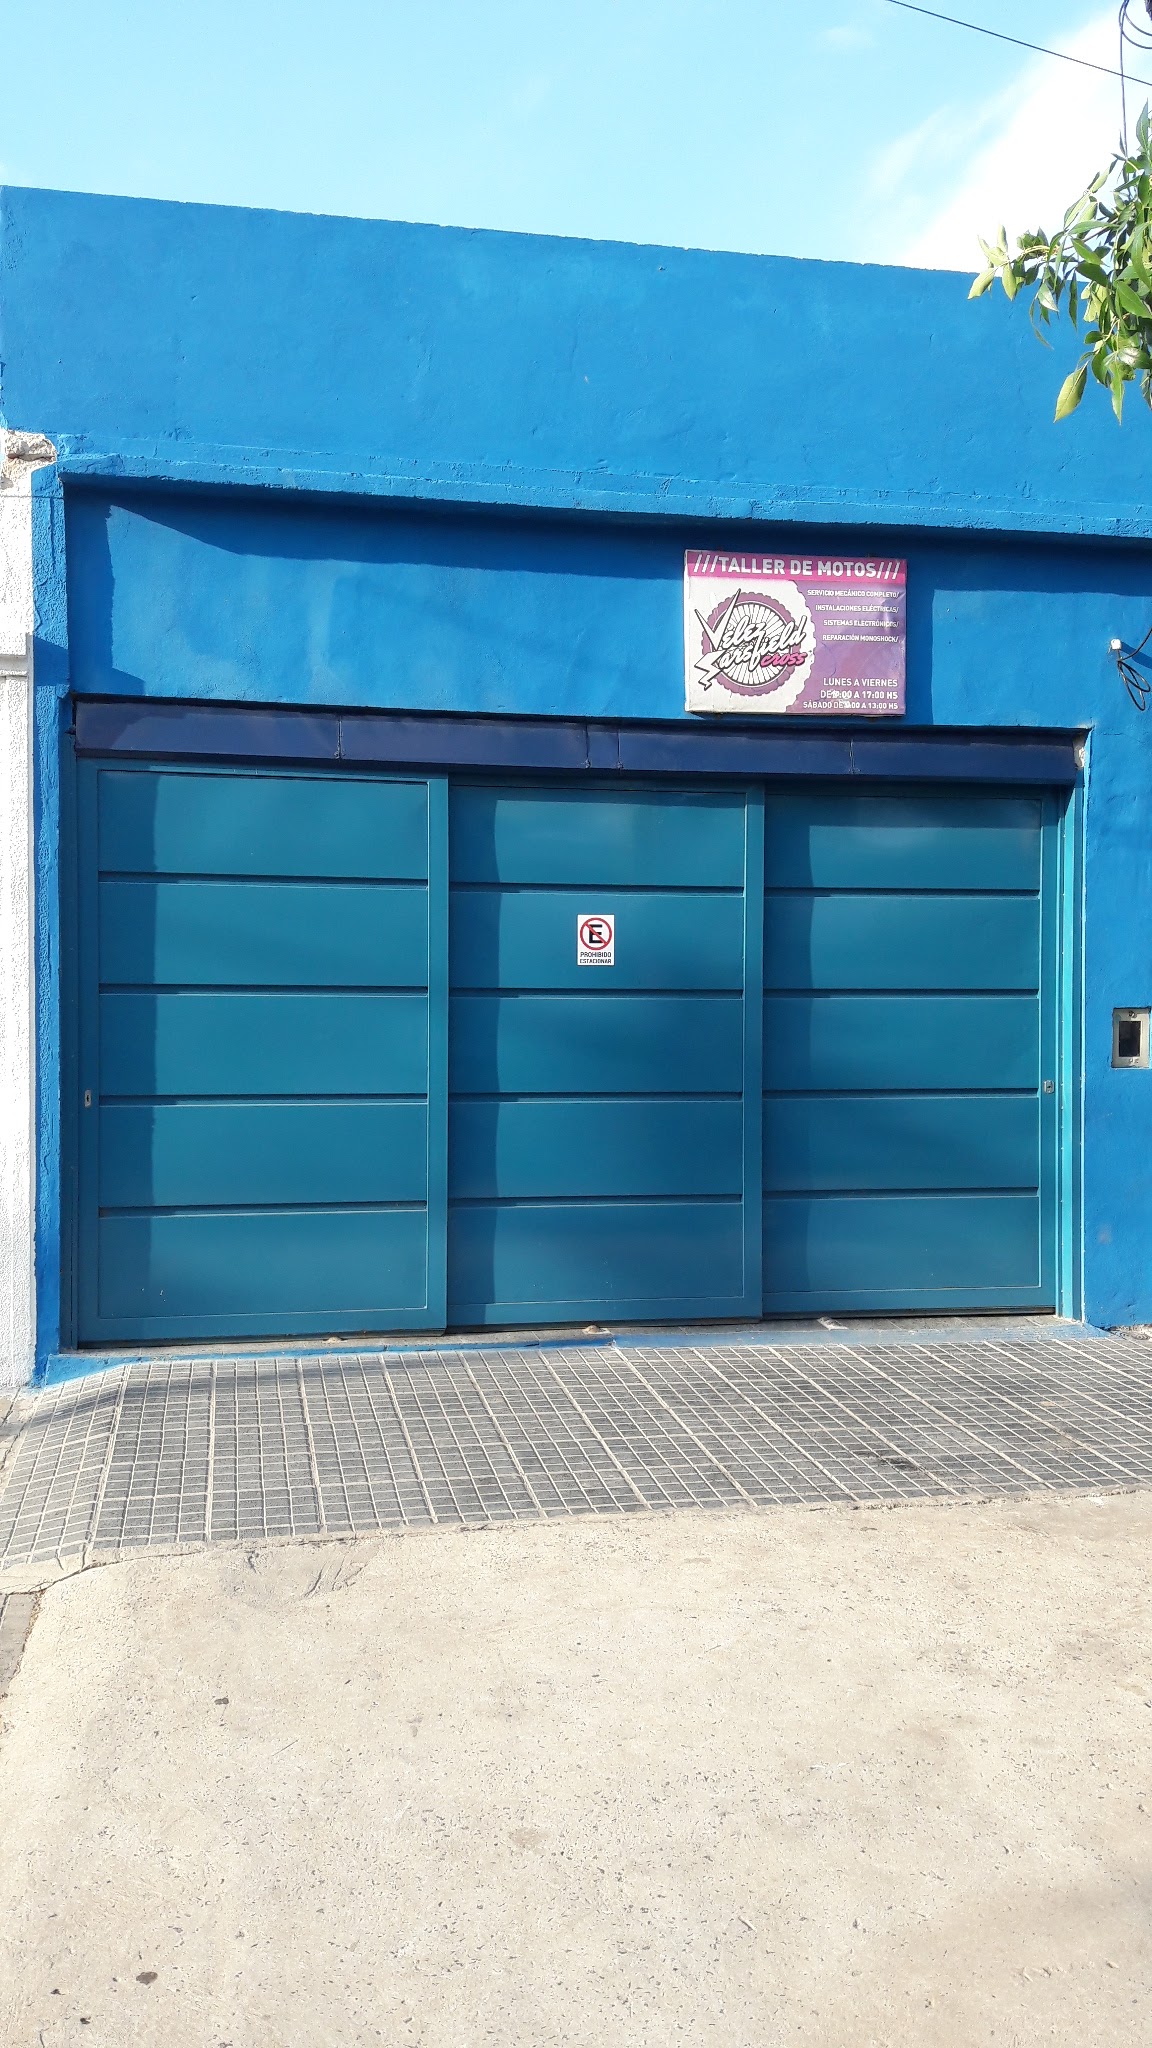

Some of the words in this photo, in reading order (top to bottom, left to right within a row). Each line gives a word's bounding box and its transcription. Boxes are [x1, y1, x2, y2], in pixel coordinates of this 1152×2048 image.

[790, 560, 812, 576] DE
[815, 604, 861, 612] INSTALACIONES
[822, 633, 859, 641] REPARACIÓN
[760, 652, 808, 668] cross
[823, 677, 852, 686] LUNES
[853, 679, 860, 687] A
[861, 678, 898, 687] VIERNES
[853, 690, 860, 699] A
[862, 690, 885, 699] 17:00
[886, 691, 898, 700] HS
[803, 700, 832, 709] SÁBADO
[833, 701, 843, 709] DE
